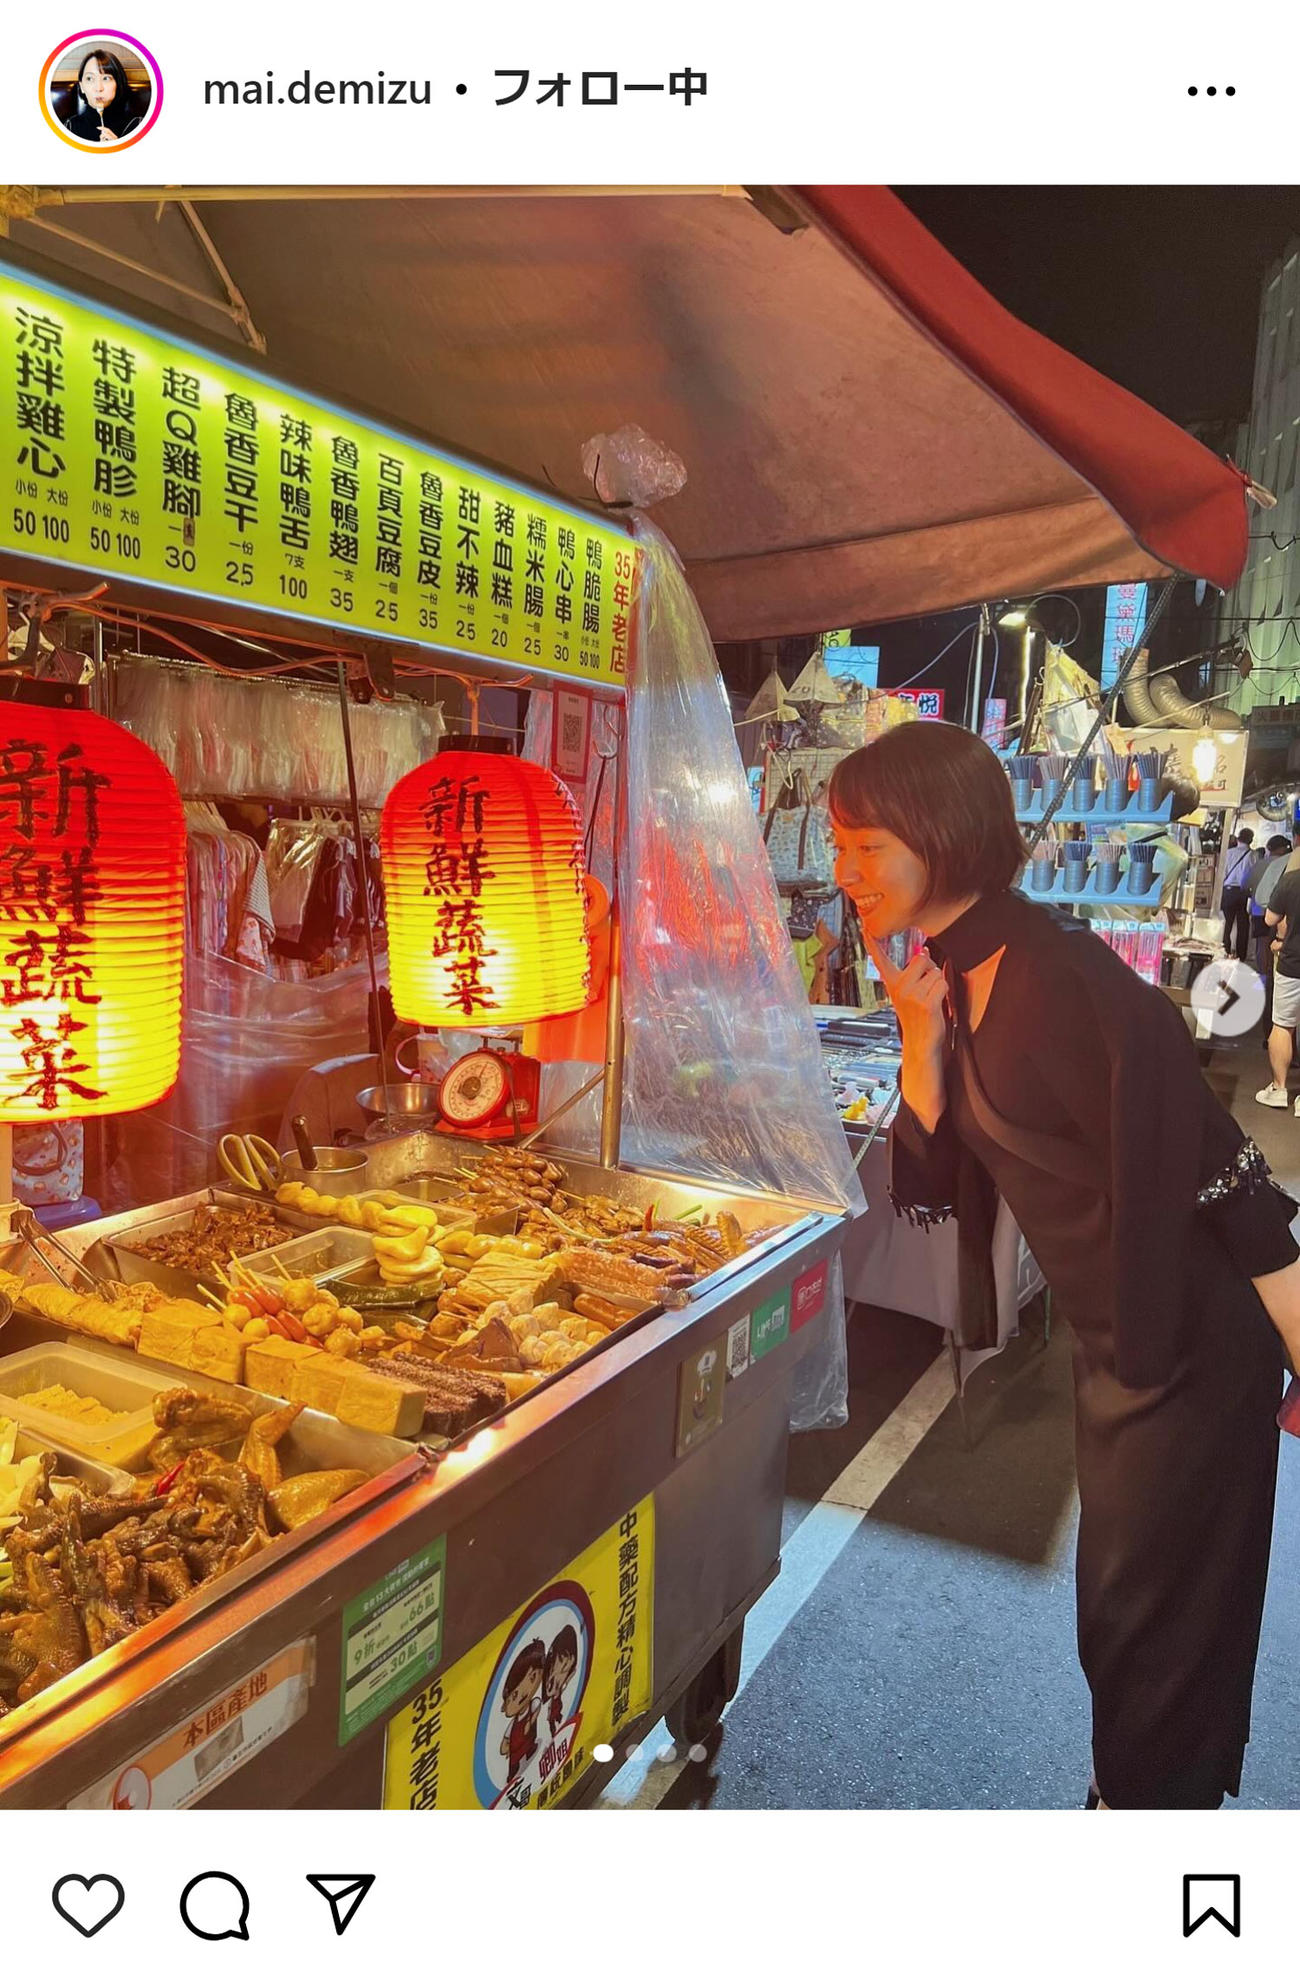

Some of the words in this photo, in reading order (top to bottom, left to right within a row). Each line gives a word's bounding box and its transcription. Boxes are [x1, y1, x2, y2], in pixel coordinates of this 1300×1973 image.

[15, 306, 66, 479] 涼拌雞心
[91, 338, 138, 498] 特製鴨胗
[162, 366, 201, 519] 超Q雞腳
[224, 391, 259, 533] 魯香豆干
[279, 412, 312, 550] 辣味鴨舌
[13, 507, 36, 536] 50
[42, 514, 70, 543] 100
[90, 526, 111, 552] 50
[116, 532, 141, 560] 100
[328, 435, 360, 565] 魯香鴨翅
[375, 452, 405, 579] 百頁豆腐
[416, 470, 444, 589] 魯香豆皮
[455, 485, 481, 599] 甜不辣
[165, 545, 197, 573] 30
[225, 560, 254, 587] 25
[279, 574, 308, 599] 100
[329, 587, 354, 613] 35
[490, 500, 516, 609] 豬血糕
[523, 512, 547, 619] 糯米腸
[555, 526, 576, 625] 鴨心串
[582, 537, 603, 635] 鴨脆腸
[375, 598, 398, 622] 25
[418, 608, 438, 630] 35
[455, 619, 476, 641] 25
[491, 628, 508, 648] 20
[524, 636, 542, 656] 25
[554, 644, 570, 663] 30
[579, 650, 589, 667] 50
[609, 550, 631, 674] 35年老店
[0, 738, 112, 1112] 新鮮蔬菜
[418, 774, 499, 1016] 新鮮蔬菜
[182, 1670, 269, 1749] 本區產地
[409, 1677, 443, 1810] 35年老店
